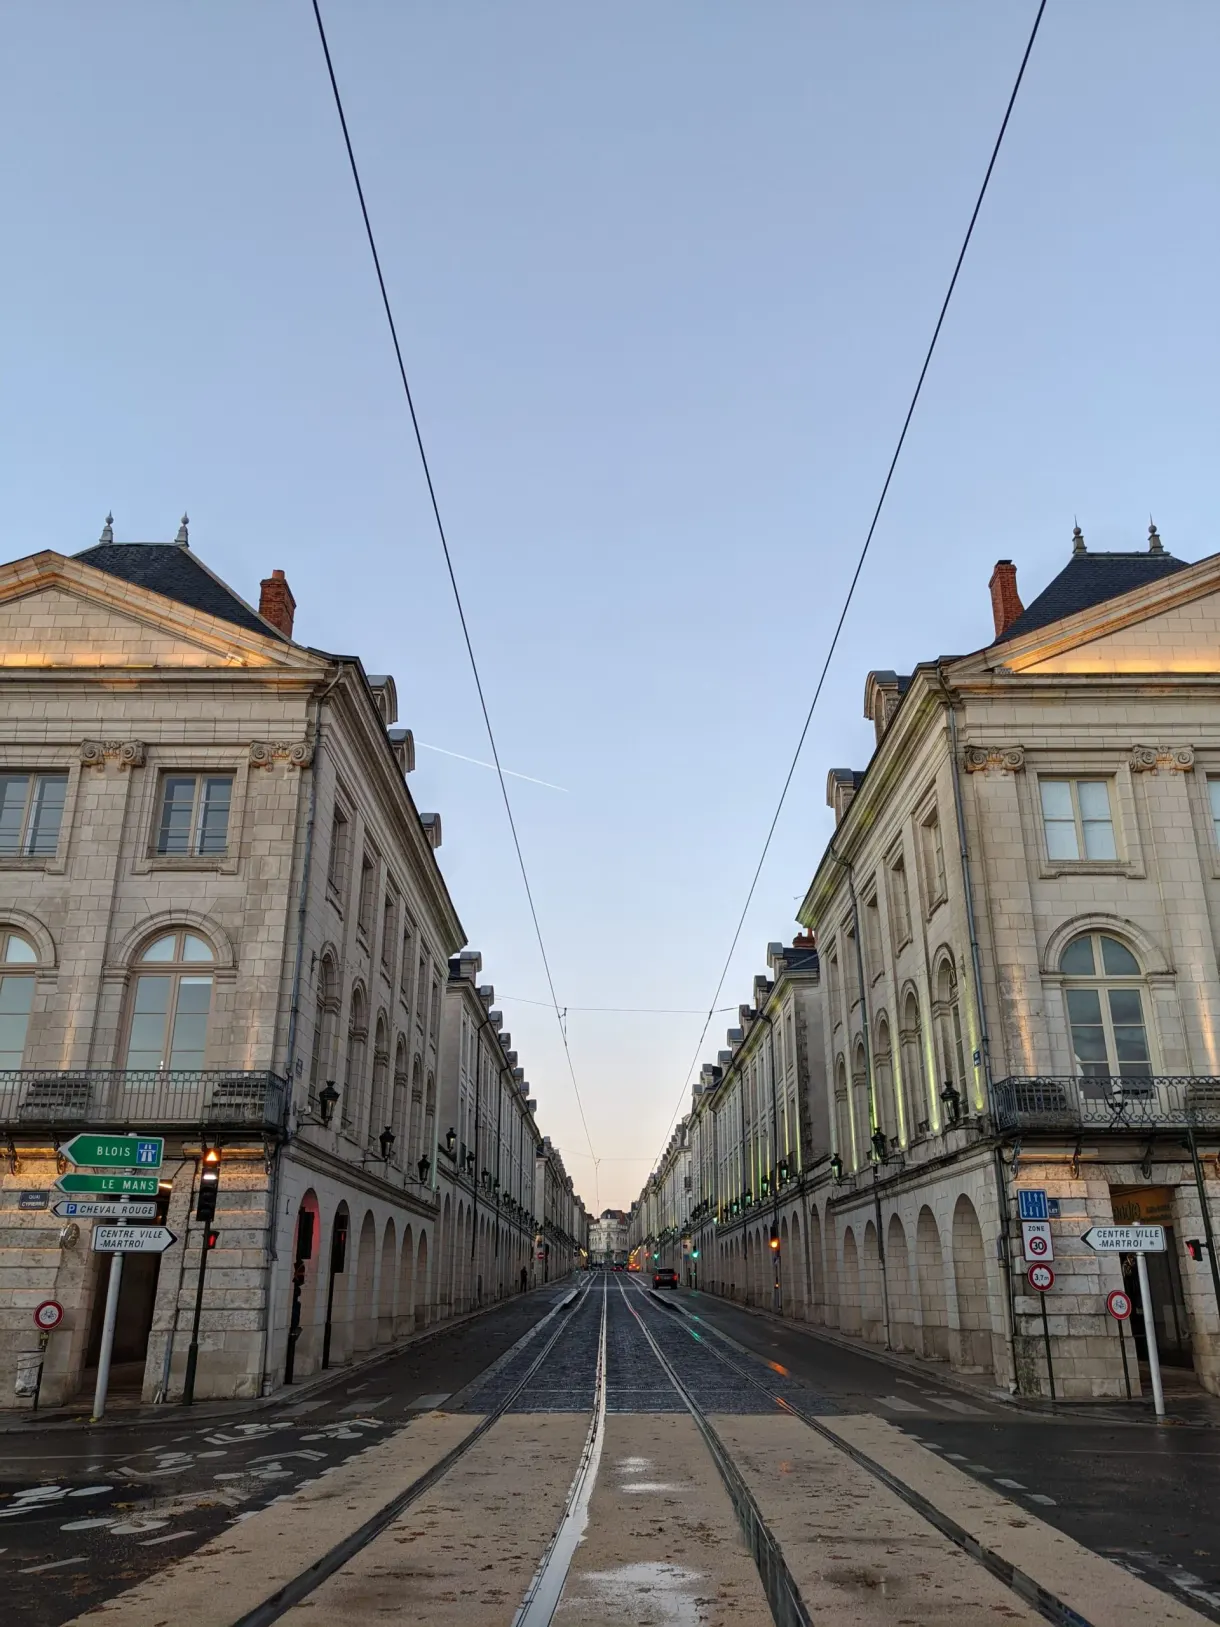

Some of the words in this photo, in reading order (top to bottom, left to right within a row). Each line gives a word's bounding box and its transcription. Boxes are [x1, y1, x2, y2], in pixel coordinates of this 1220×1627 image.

[97, 1146, 131, 1156] BLOIS
[102, 1180, 114, 1189] LE
[123, 1180, 154, 1190] MANS
[80, 1205, 116, 1214] CHEVAL
[121, 1206, 154, 1215] ROUGE
[100, 1229, 135, 1238] CENTRE
[140, 1230, 163, 1239] VILLE
[1096, 1229, 1130, 1238] CENTRE
[1135, 1229, 1159, 1238] VILLE
[1032, 1241, 1044, 1251] 30
